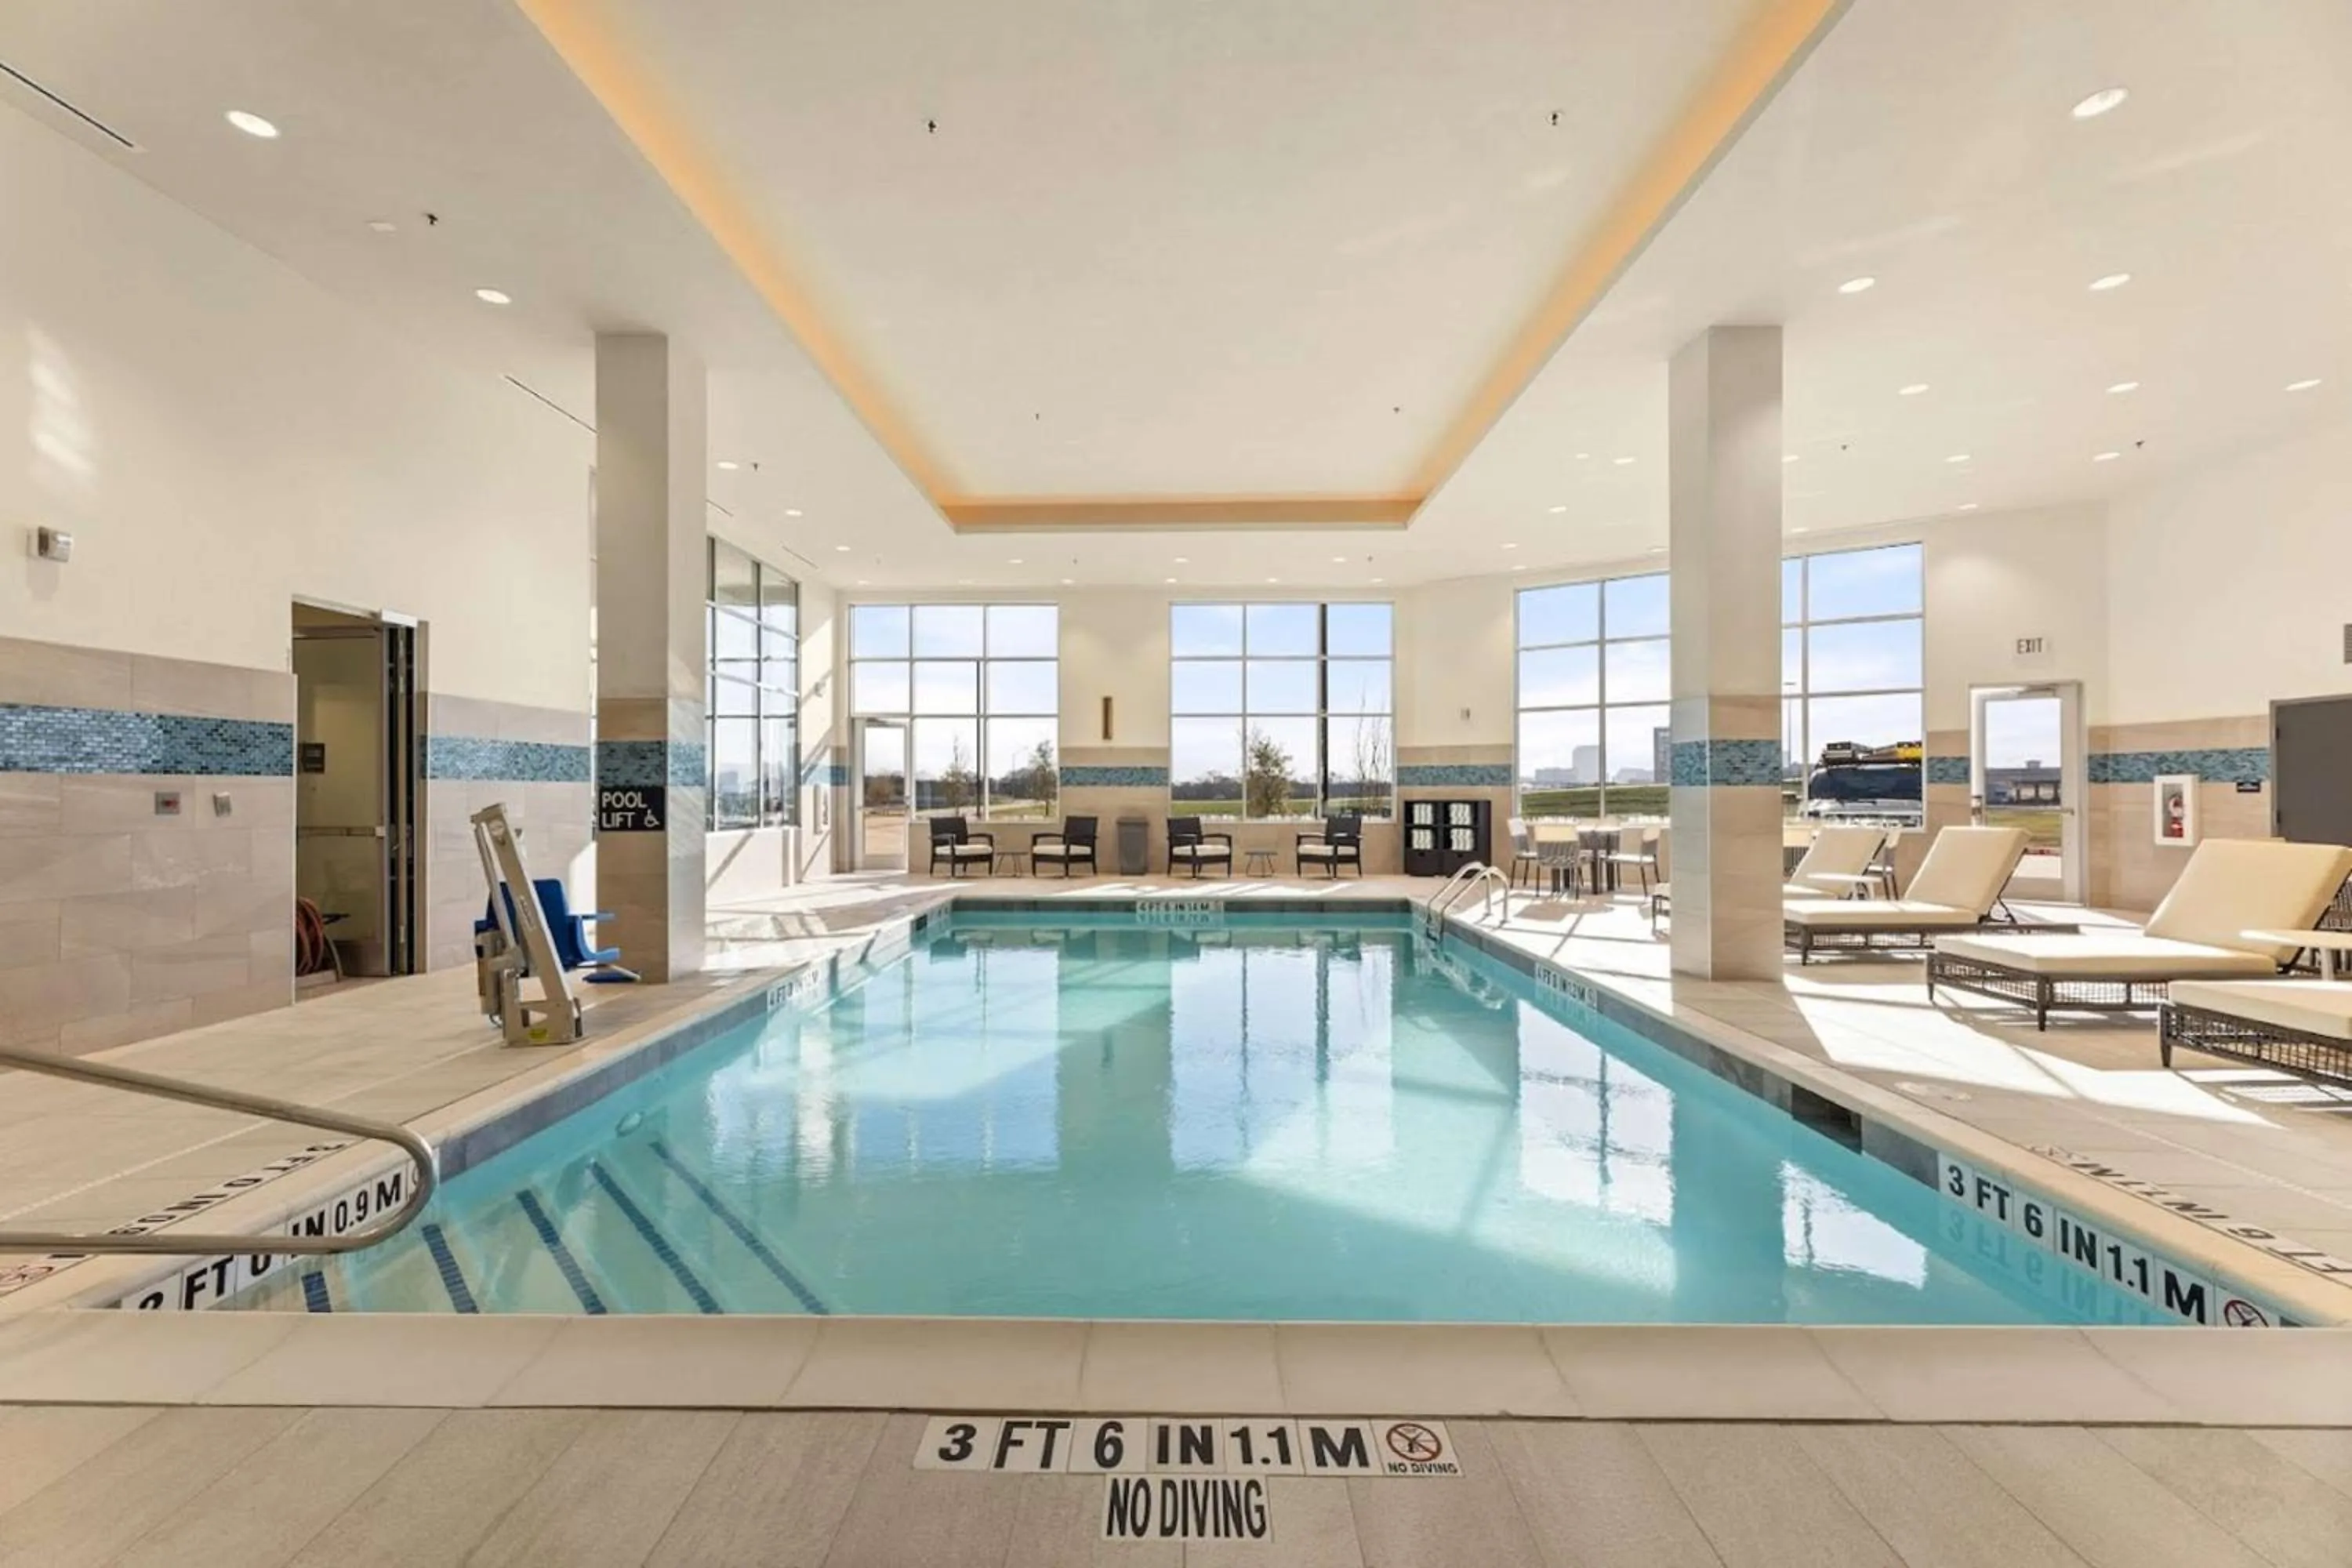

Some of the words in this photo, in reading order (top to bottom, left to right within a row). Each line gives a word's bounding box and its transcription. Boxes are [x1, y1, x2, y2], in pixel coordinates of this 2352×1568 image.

[2016, 637, 2043, 655] EXIT
[601, 791, 648, 808] POOL
[601, 811, 636, 828] LIFT
[184, 1254, 234, 1309] FT
[335, 1190, 368, 1234] 0.9
[376, 1173, 402, 1213] M
[1948, 1164, 1964, 1197] 3
[1976, 1177, 2010, 1221] FT
[2024, 1203, 2044, 1238] 6
[2060, 1218, 2097, 1270] IN
[2107, 1245, 2148, 1295] 1.1
[2163, 1269, 2206, 1325] M
[938, 1423, 978, 1462] 3
[993, 1421, 1071, 1470] FT
[1094, 1421, 1124, 1469] 6
[1156, 1425, 1214, 1465] IN
[1229, 1425, 1293, 1466] 1.1
[1308, 1427, 1370, 1468] M
[1388, 1462, 1407, 1473] NO
[1411, 1462, 1458, 1474] DIVING
[1105, 1477, 1152, 1538] NO
[1160, 1479, 1267, 1539] DIVING
